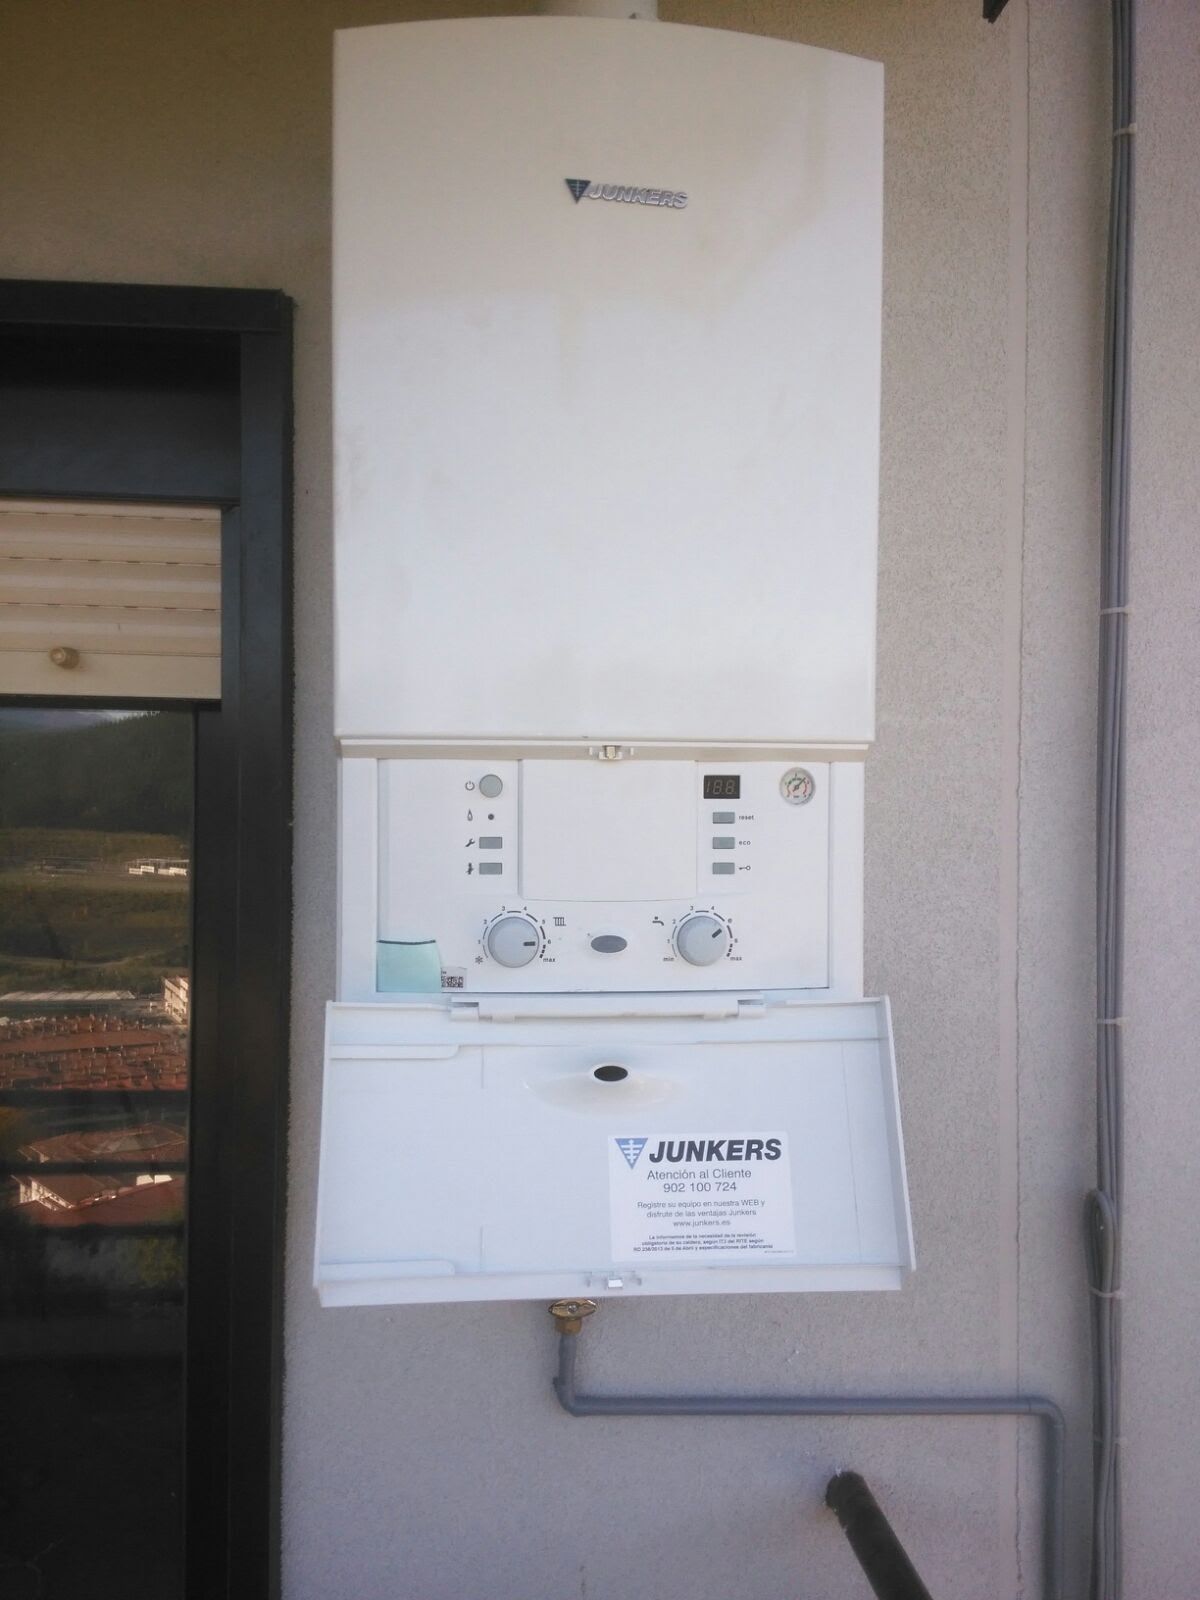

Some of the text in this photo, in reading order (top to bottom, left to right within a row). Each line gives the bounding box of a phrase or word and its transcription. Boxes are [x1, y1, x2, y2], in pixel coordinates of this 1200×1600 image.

[588, 183, 688, 209] JUNKERS
[649, 1138, 782, 1164] JUNKERS
[647, 1168, 752, 1181] Atención al Cliente
[663, 1181, 737, 1193] 902 100 724
[637, 1201, 667, 1210] Registre
[678, 1201, 701, 1209] equipo
[647, 1210, 673, 1218] disfrute
[685, 1209, 696, 1217] las
[697, 1209, 727, 1218] ventajas
[728, 1208, 757, 1216] Junkers
[673, 1218, 731, 1228] www.junkers.es
